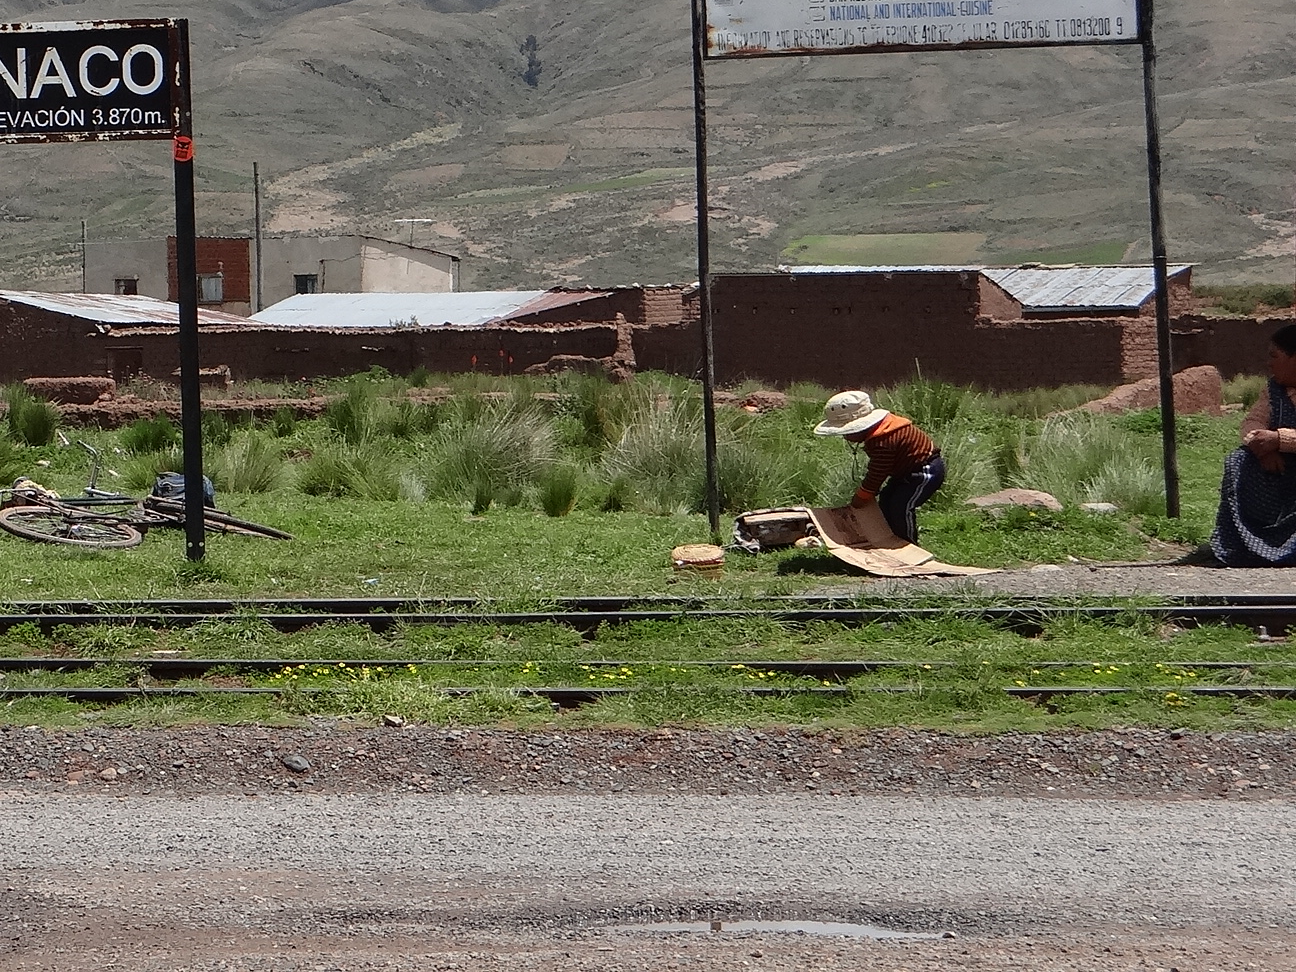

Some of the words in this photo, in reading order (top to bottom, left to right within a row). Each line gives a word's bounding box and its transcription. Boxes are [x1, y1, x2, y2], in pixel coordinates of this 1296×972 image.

[829, 4, 871, 21] NATIONAL
[873, 3, 891, 20] AND
[893, 1, 956, 19] INTERNATIONAL
